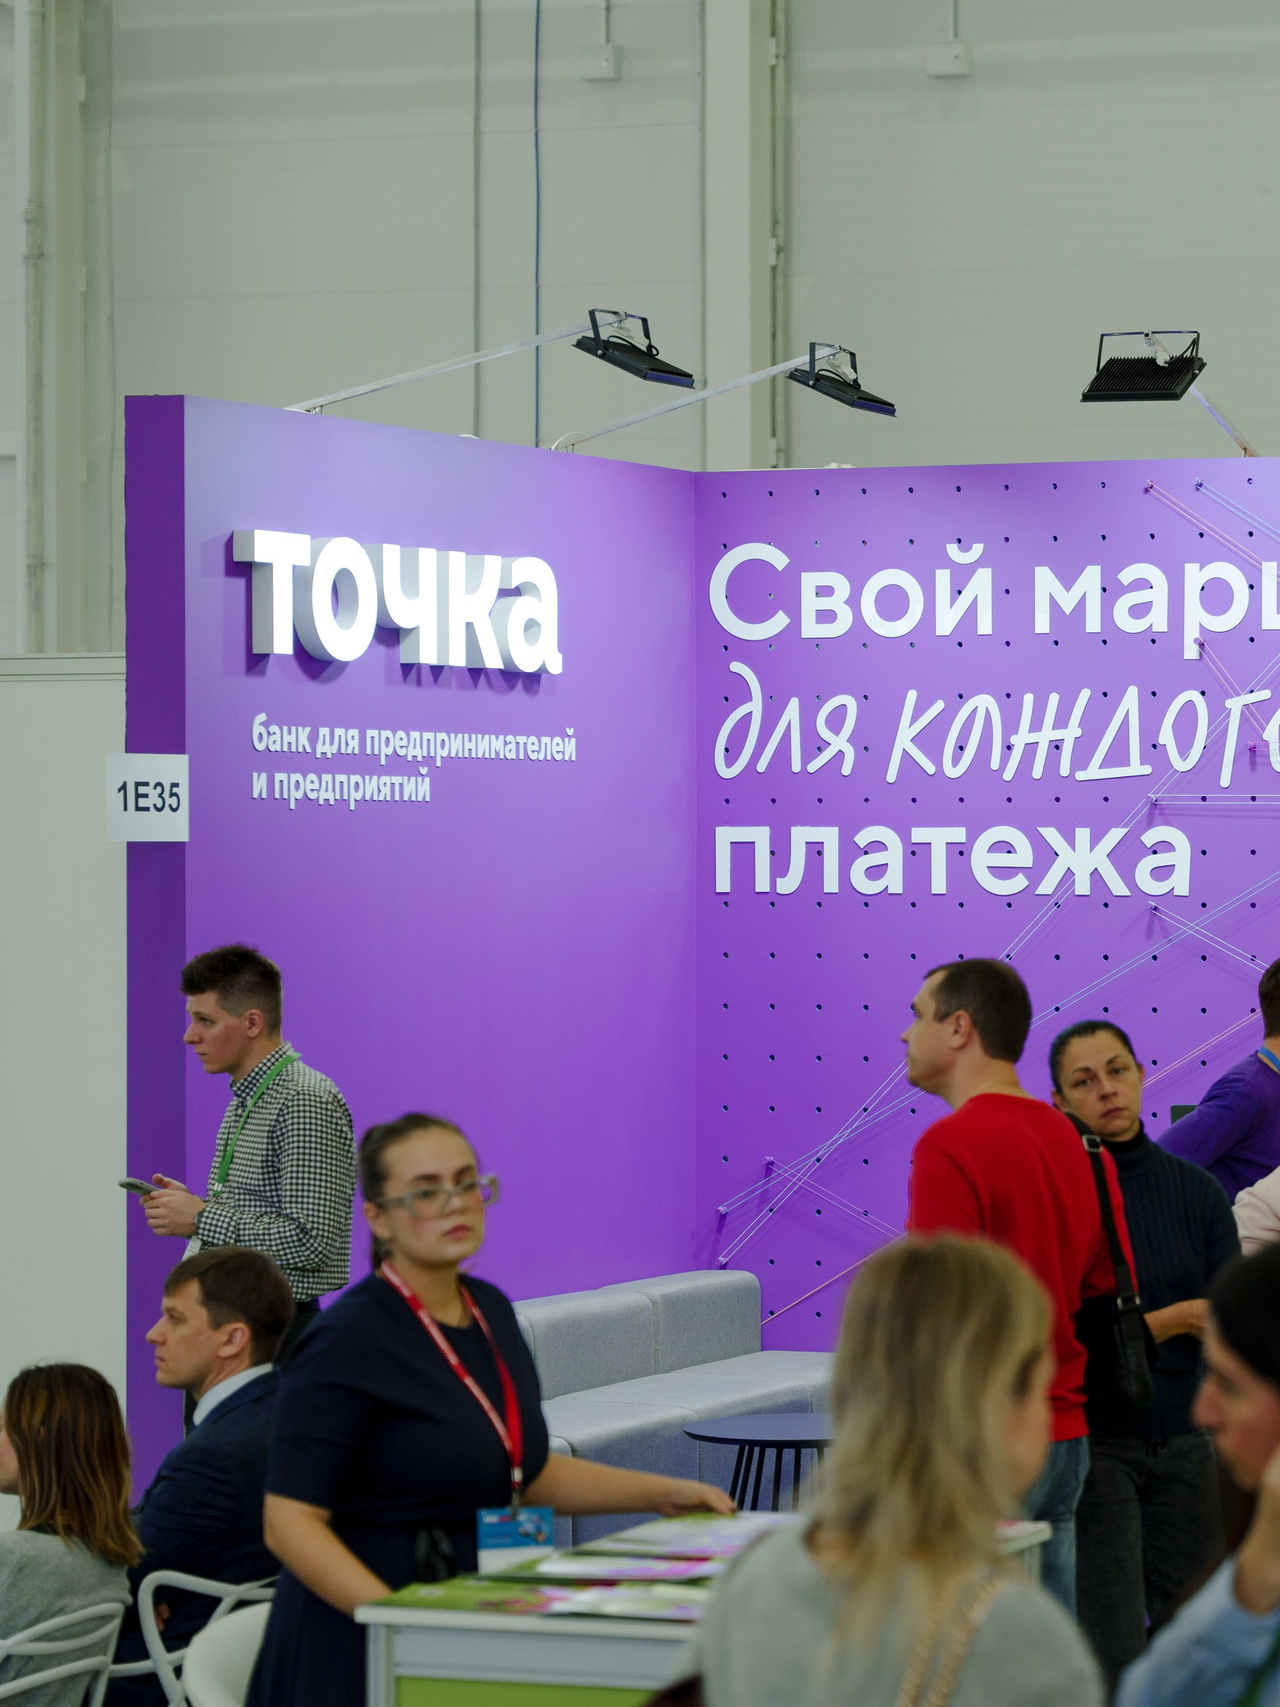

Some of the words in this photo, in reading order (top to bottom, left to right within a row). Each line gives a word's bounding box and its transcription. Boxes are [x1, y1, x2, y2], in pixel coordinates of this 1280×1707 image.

[233, 529, 562, 674] точка
[709, 542, 994, 640] Свой
[252, 713, 310, 753] банк
[316, 727, 359, 757] для
[366, 728, 577, 766] предпринимателей
[714, 661, 857, 780] для
[116, 780, 181, 813] 1E35
[252, 772, 267, 800] и
[274, 767, 431, 811] предприятий
[714, 824, 1194, 898] платежа
